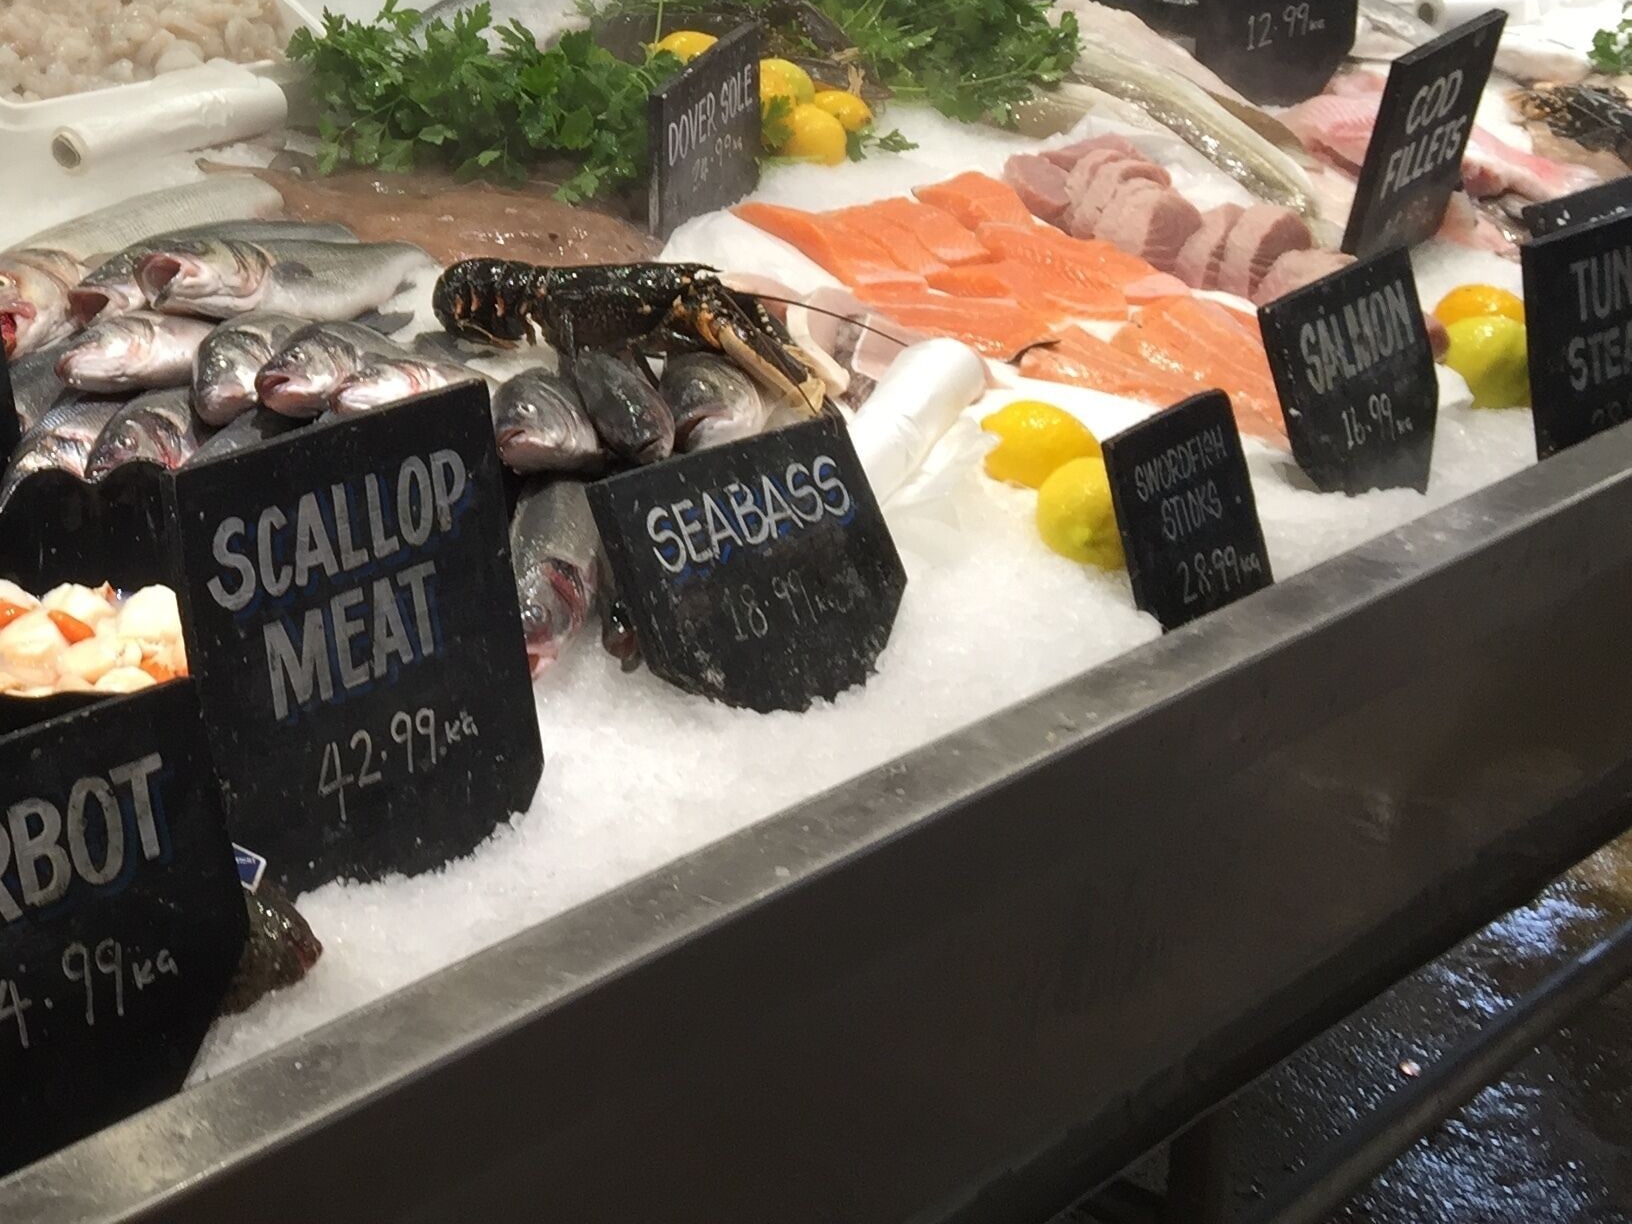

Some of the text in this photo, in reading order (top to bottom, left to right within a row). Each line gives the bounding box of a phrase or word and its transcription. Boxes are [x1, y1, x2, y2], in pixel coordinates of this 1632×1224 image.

[668, 64, 752, 166] DOVER SOLE
[1380, 115, 1467, 200] FILLETS
[1406, 69, 1463, 134] COD
[1300, 281, 1415, 395] SALMON
[207, 449, 467, 612] SCALLOP
[647, 455, 850, 573] SEABASS
[264, 561, 436, 721] MEAT
